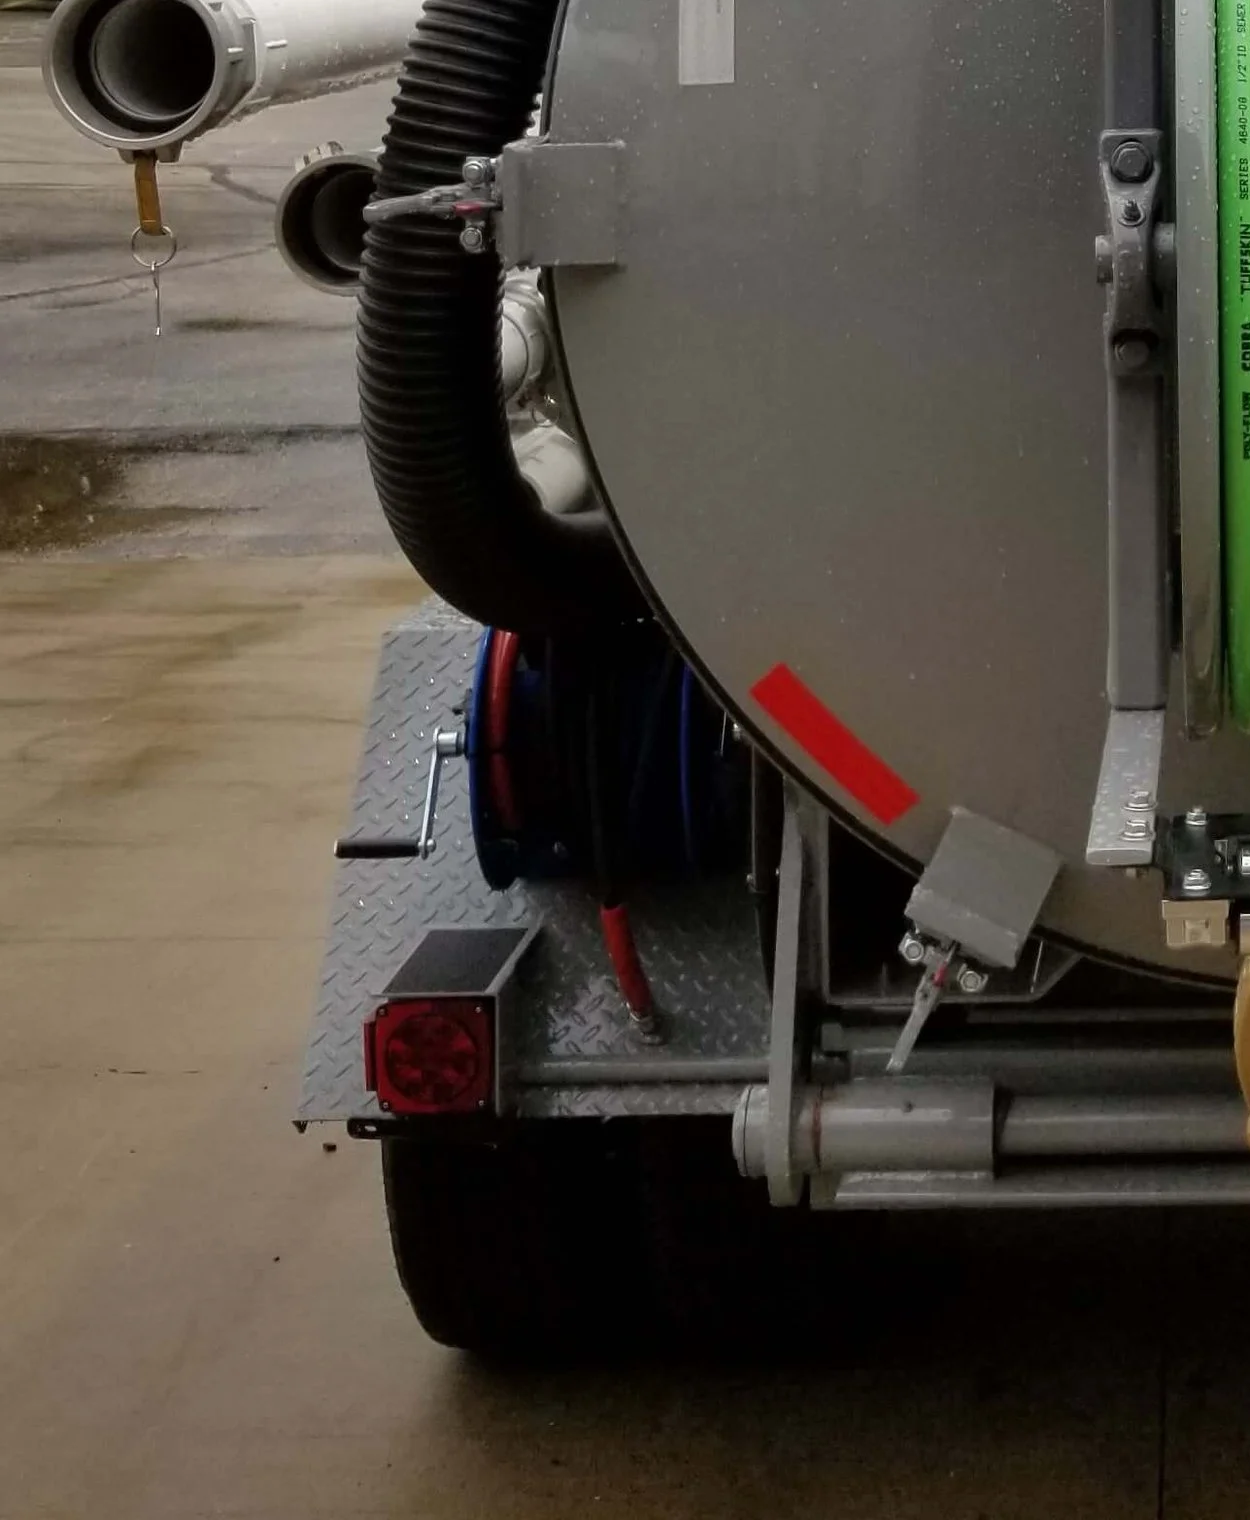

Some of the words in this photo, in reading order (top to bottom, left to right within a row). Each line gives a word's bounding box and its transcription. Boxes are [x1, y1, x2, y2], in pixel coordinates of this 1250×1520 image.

[1236, 3, 1247, 34] SEWER
[1237, 45, 1247, 60] ID
[1238, 96, 1248, 144] 4640-08
[1238, 158, 1249, 200] SERIES
